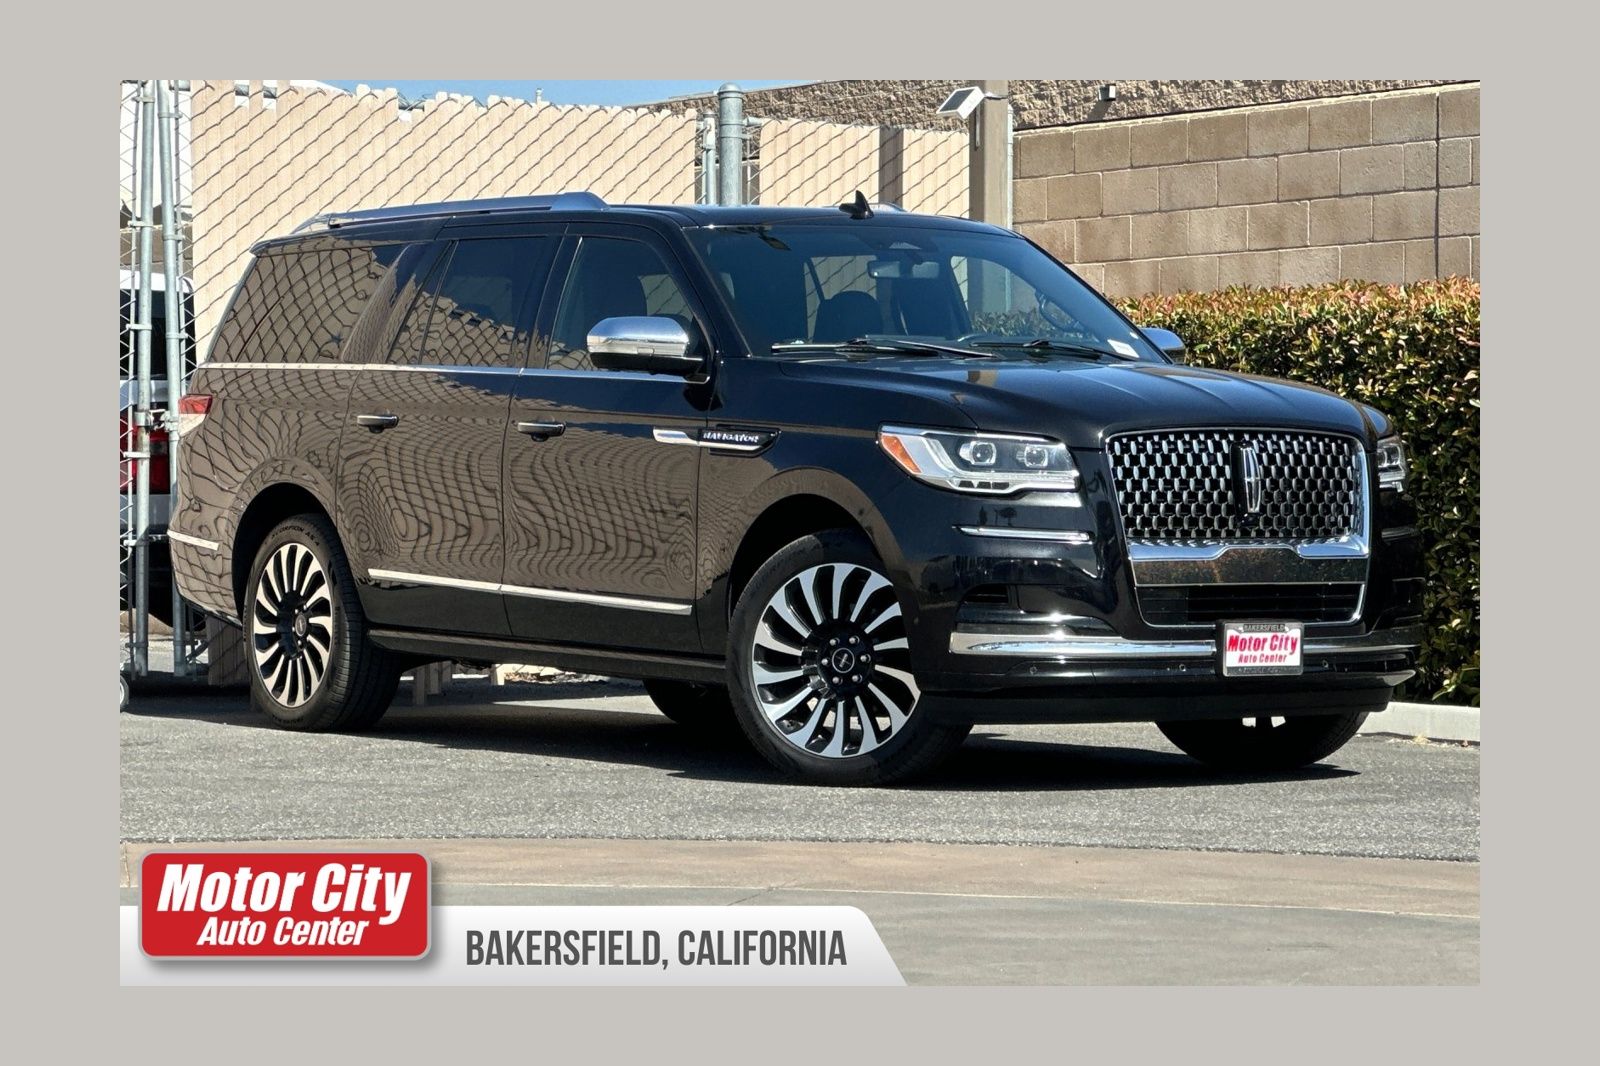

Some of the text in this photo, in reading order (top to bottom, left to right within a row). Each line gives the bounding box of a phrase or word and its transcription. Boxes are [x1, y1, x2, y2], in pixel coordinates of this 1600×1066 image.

[703, 431, 759, 443] NAVIGATOR
[1226, 634, 1298, 655] Motor City
[1238, 653, 1287, 664] Auto Center
